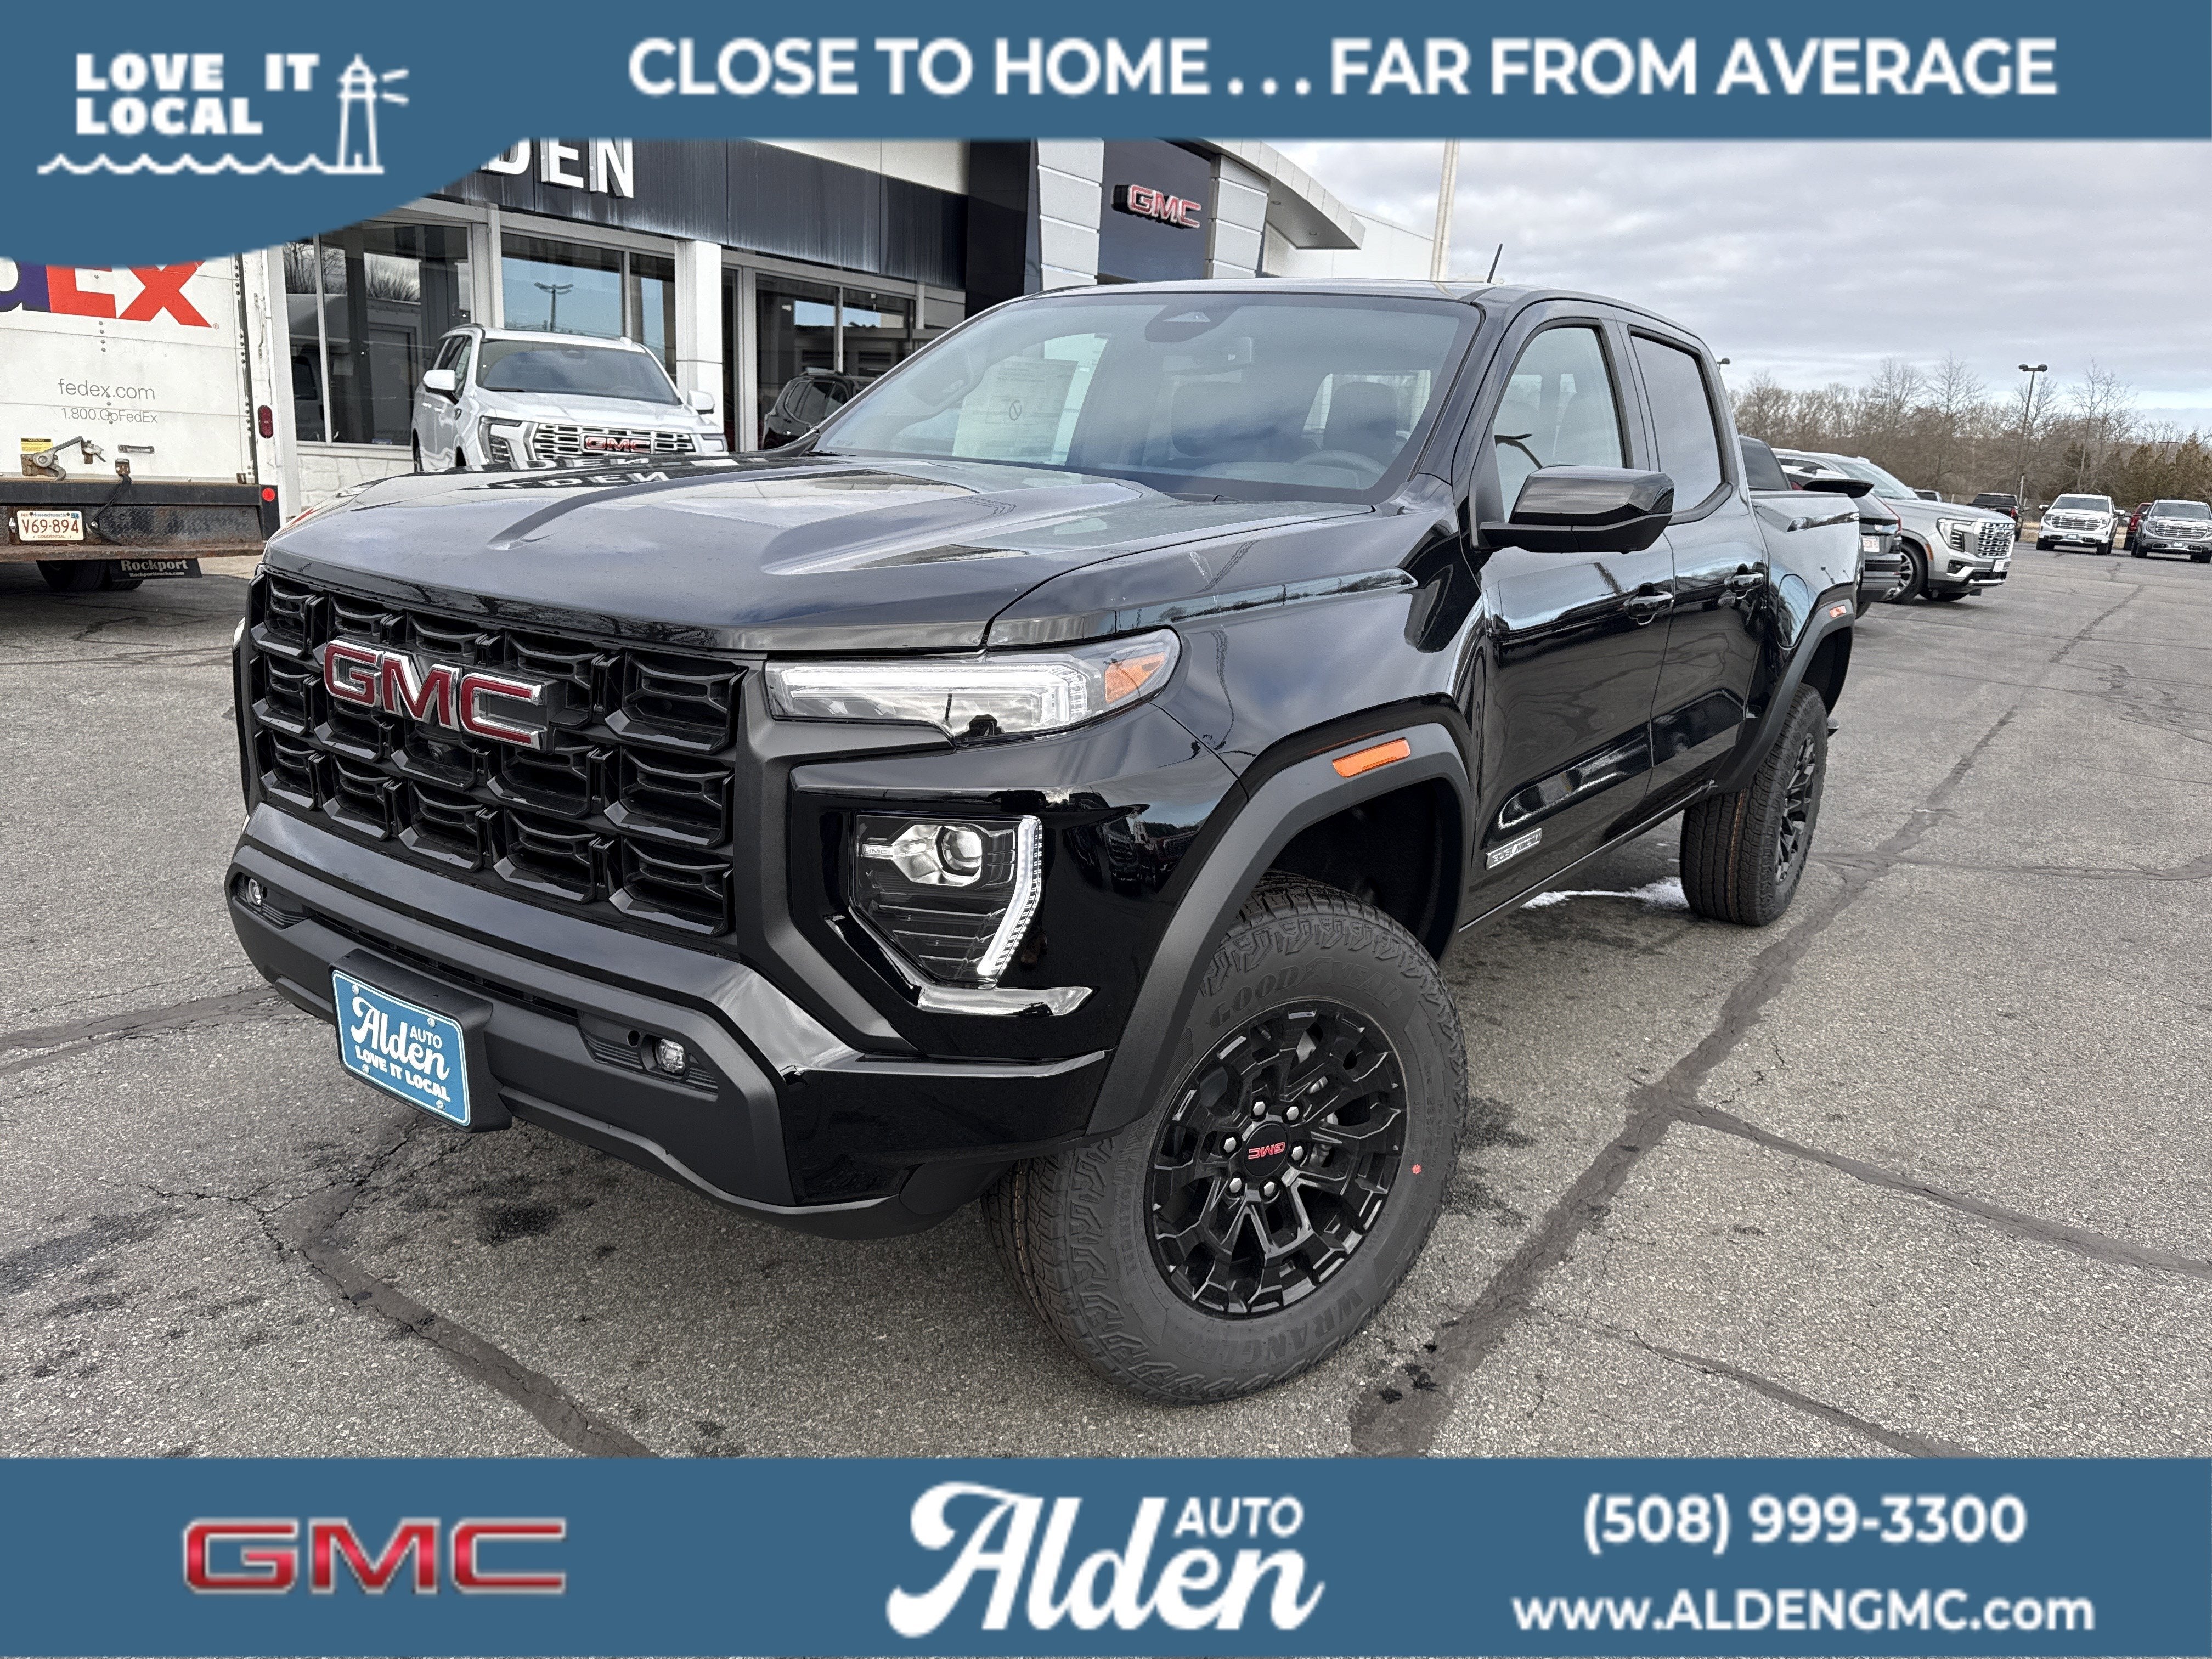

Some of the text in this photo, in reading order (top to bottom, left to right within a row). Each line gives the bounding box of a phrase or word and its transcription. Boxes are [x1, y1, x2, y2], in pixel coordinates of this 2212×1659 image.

[1128, 184, 1201, 228] GMC
[58, 378, 155, 400] fedex.com
[61, 407, 158, 423] 1.800.GoFedEx
[585, 437, 651, 454] GMC
[121, 560, 188, 572] Rockport
[324, 640, 548, 751] GMC
[1210, 957, 1403, 1030] GOODYEAR
[351, 996, 450, 1081] Alden
[410, 1026, 442, 1049] AUTO
[355, 1045, 451, 1102] LOVE IT LOCAL
[1248, 1142, 1285, 1160] GMC
